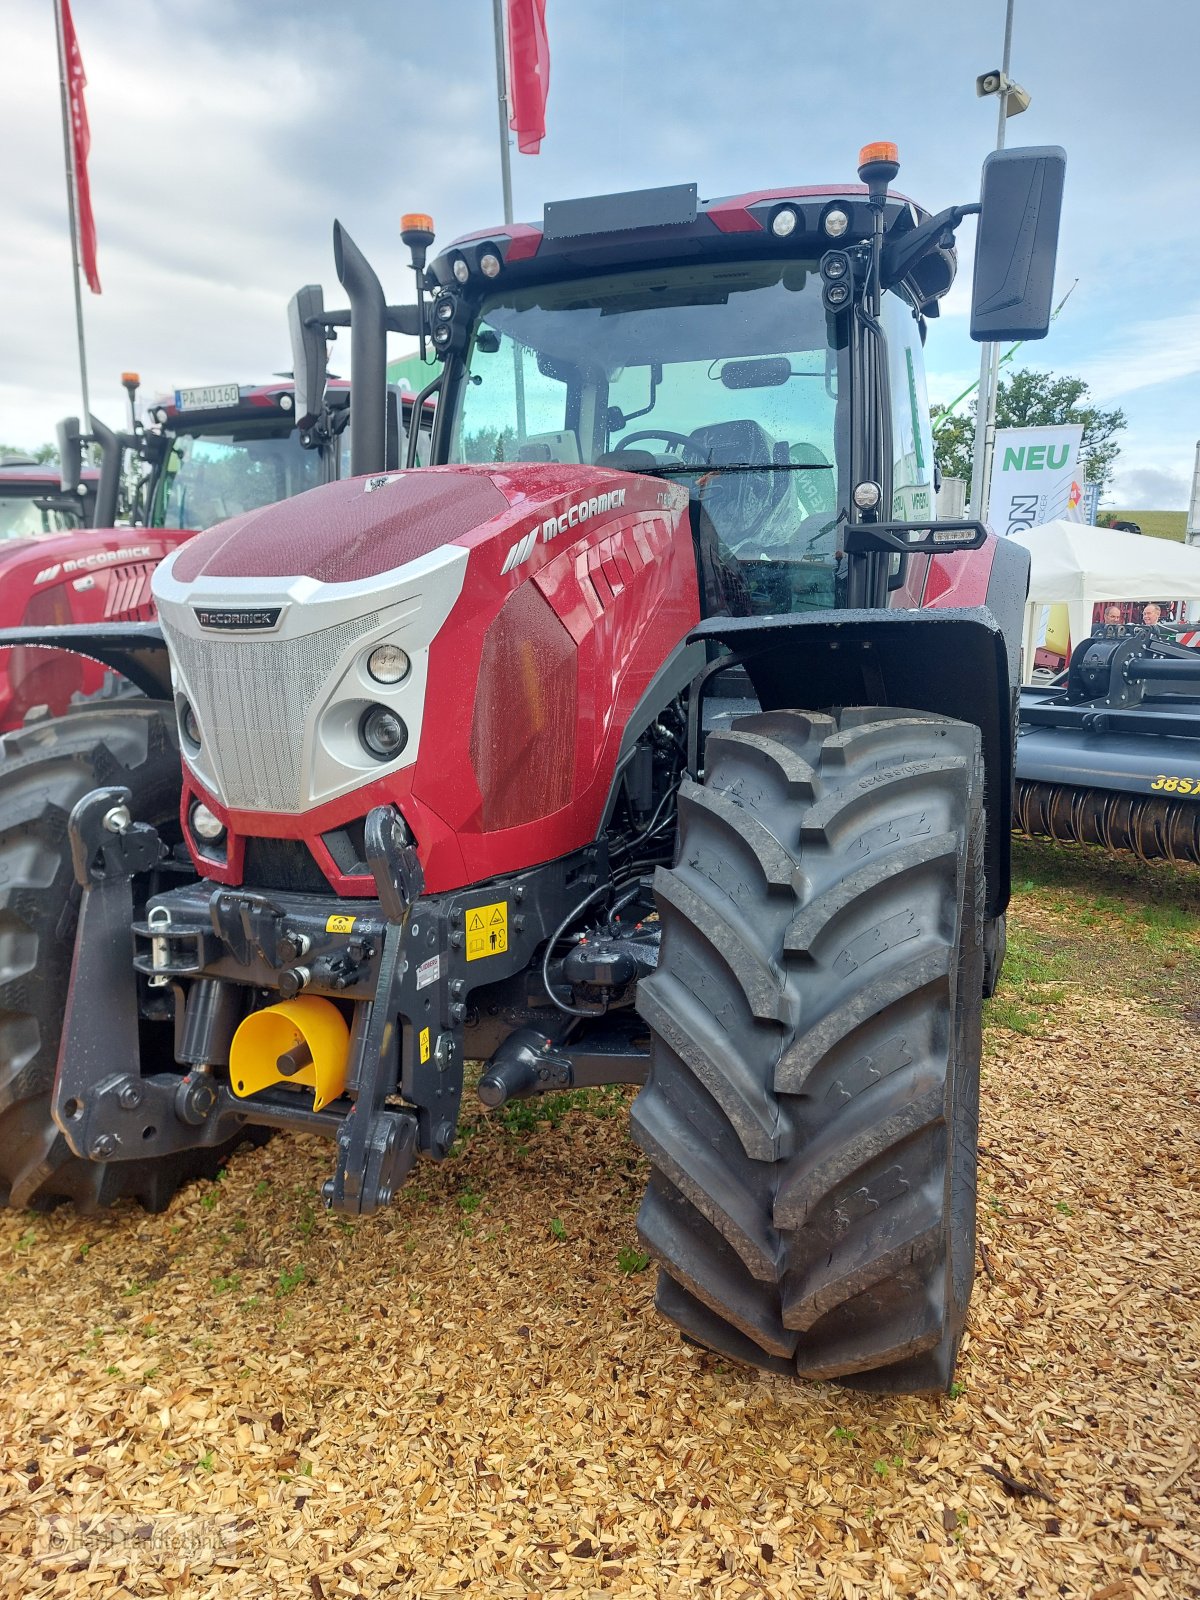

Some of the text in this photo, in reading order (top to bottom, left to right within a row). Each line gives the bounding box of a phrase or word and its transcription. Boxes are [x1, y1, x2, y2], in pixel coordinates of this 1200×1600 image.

[182, 391, 196, 404] PA
[1002, 444, 1070, 471] NEU
[542, 488, 626, 543] McCORMICK
[1037, 494, 1049, 524] ACKER
[62, 546, 150, 572] McCORMICK
